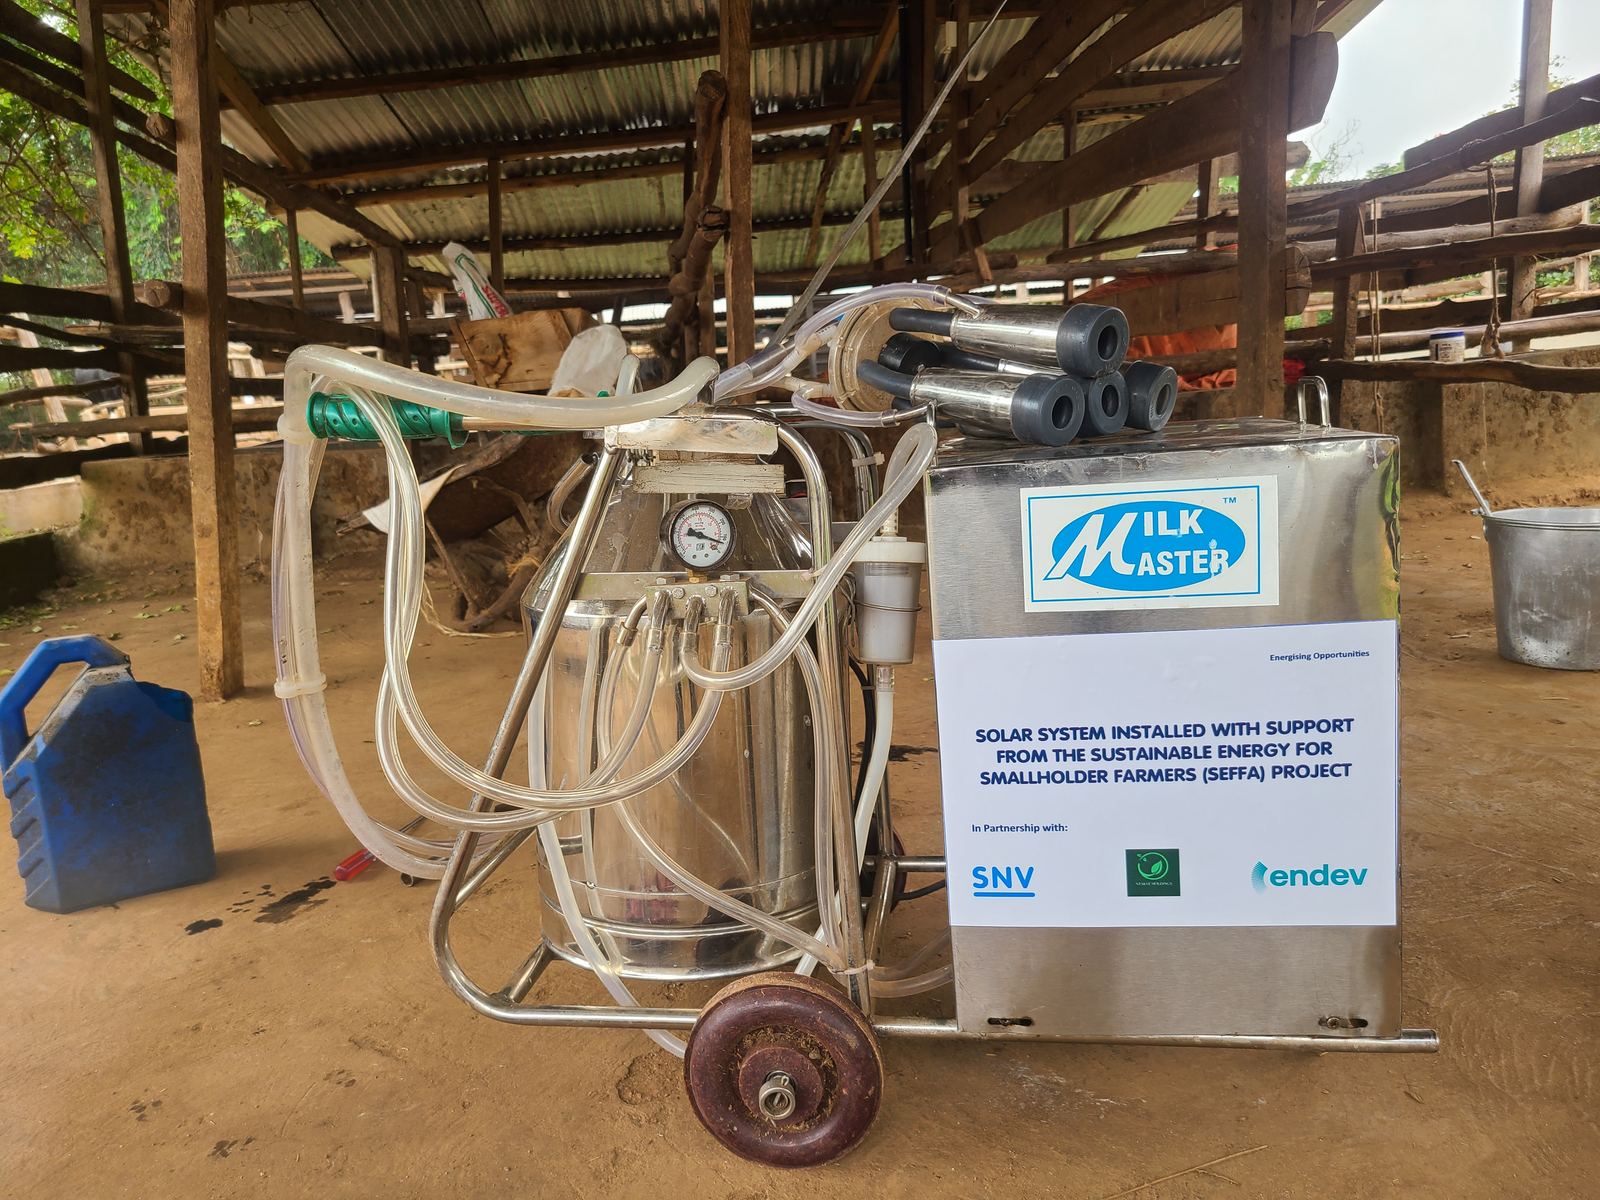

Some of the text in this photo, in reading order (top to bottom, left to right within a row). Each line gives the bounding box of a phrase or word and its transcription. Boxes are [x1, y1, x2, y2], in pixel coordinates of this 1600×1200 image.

[1269, 650, 1370, 661] Energising Opportunities
[975, 718, 1354, 743] SOLAR SYSTEM INSTALLED WITH SUPPORT
[996, 741, 1333, 764] FROM THE SUSTAINABLE ENERGY FOR
[980, 763, 1352, 785] SMALLHOLDER FARMERS (SEFFA) PROJECT
[971, 823, 1068, 834] In Partnership with:
[972, 866, 1034, 889] SNV
[1269, 863, 1368, 887] endev
